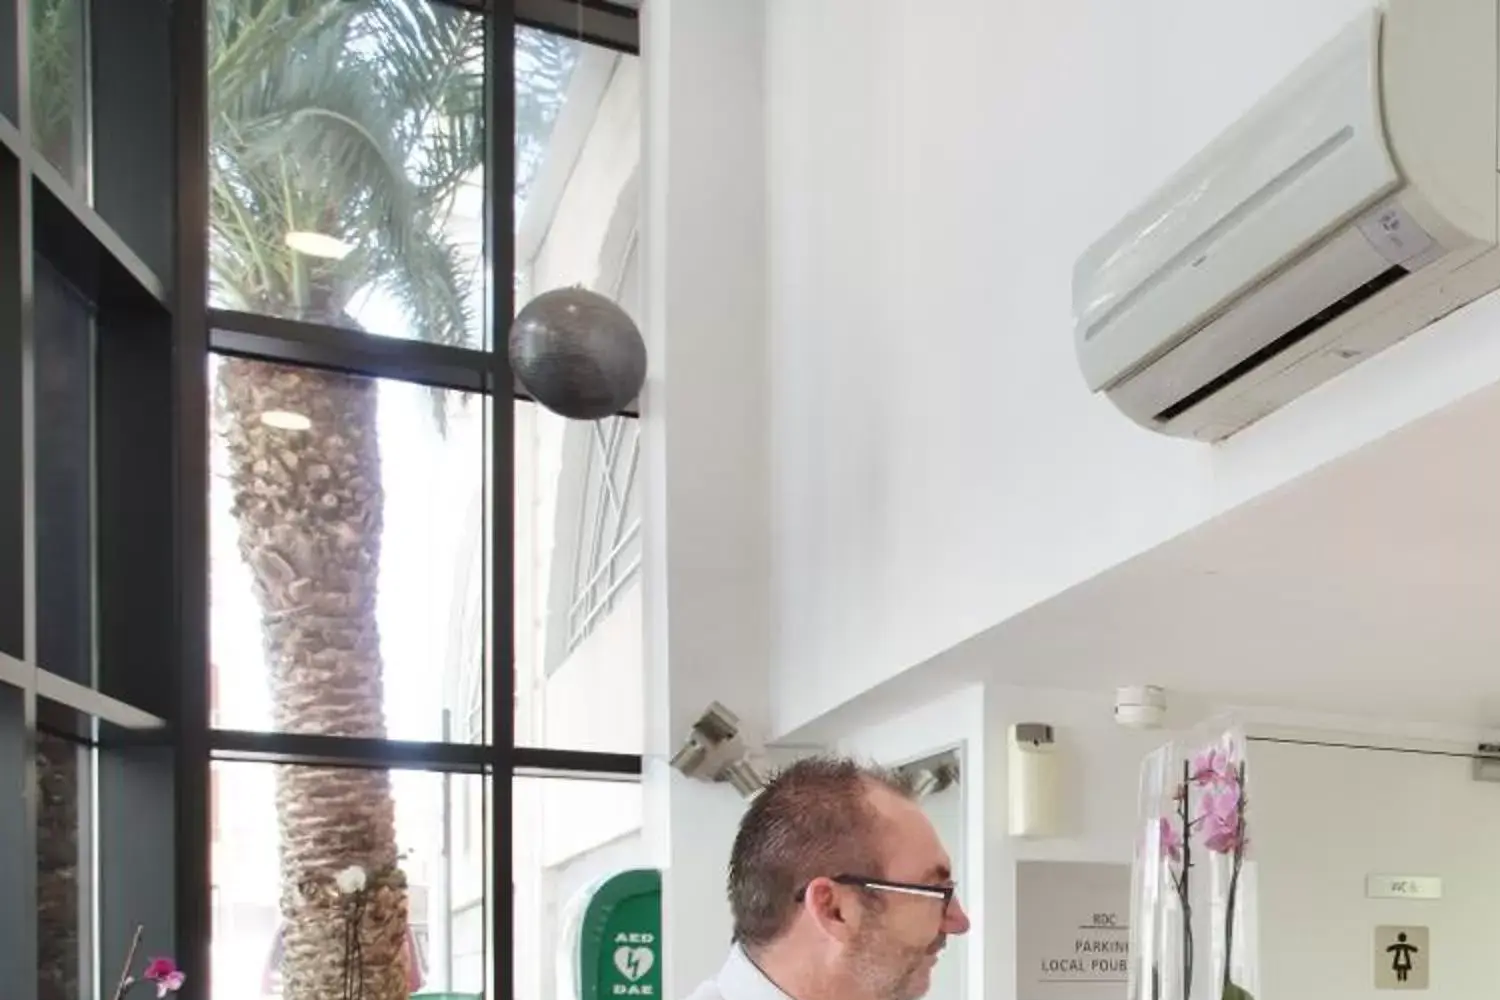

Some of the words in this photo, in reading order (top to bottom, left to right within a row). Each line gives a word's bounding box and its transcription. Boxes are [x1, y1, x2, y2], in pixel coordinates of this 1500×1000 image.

[1093, 913, 1117, 926] RDC
[614, 932, 655, 944] AED
[1075, 939, 1129, 954] PARKIN
[1041, 959, 1084, 972] LOCAL
[1091, 959, 1128, 972] POUB
[612, 984, 654, 995] DAE
